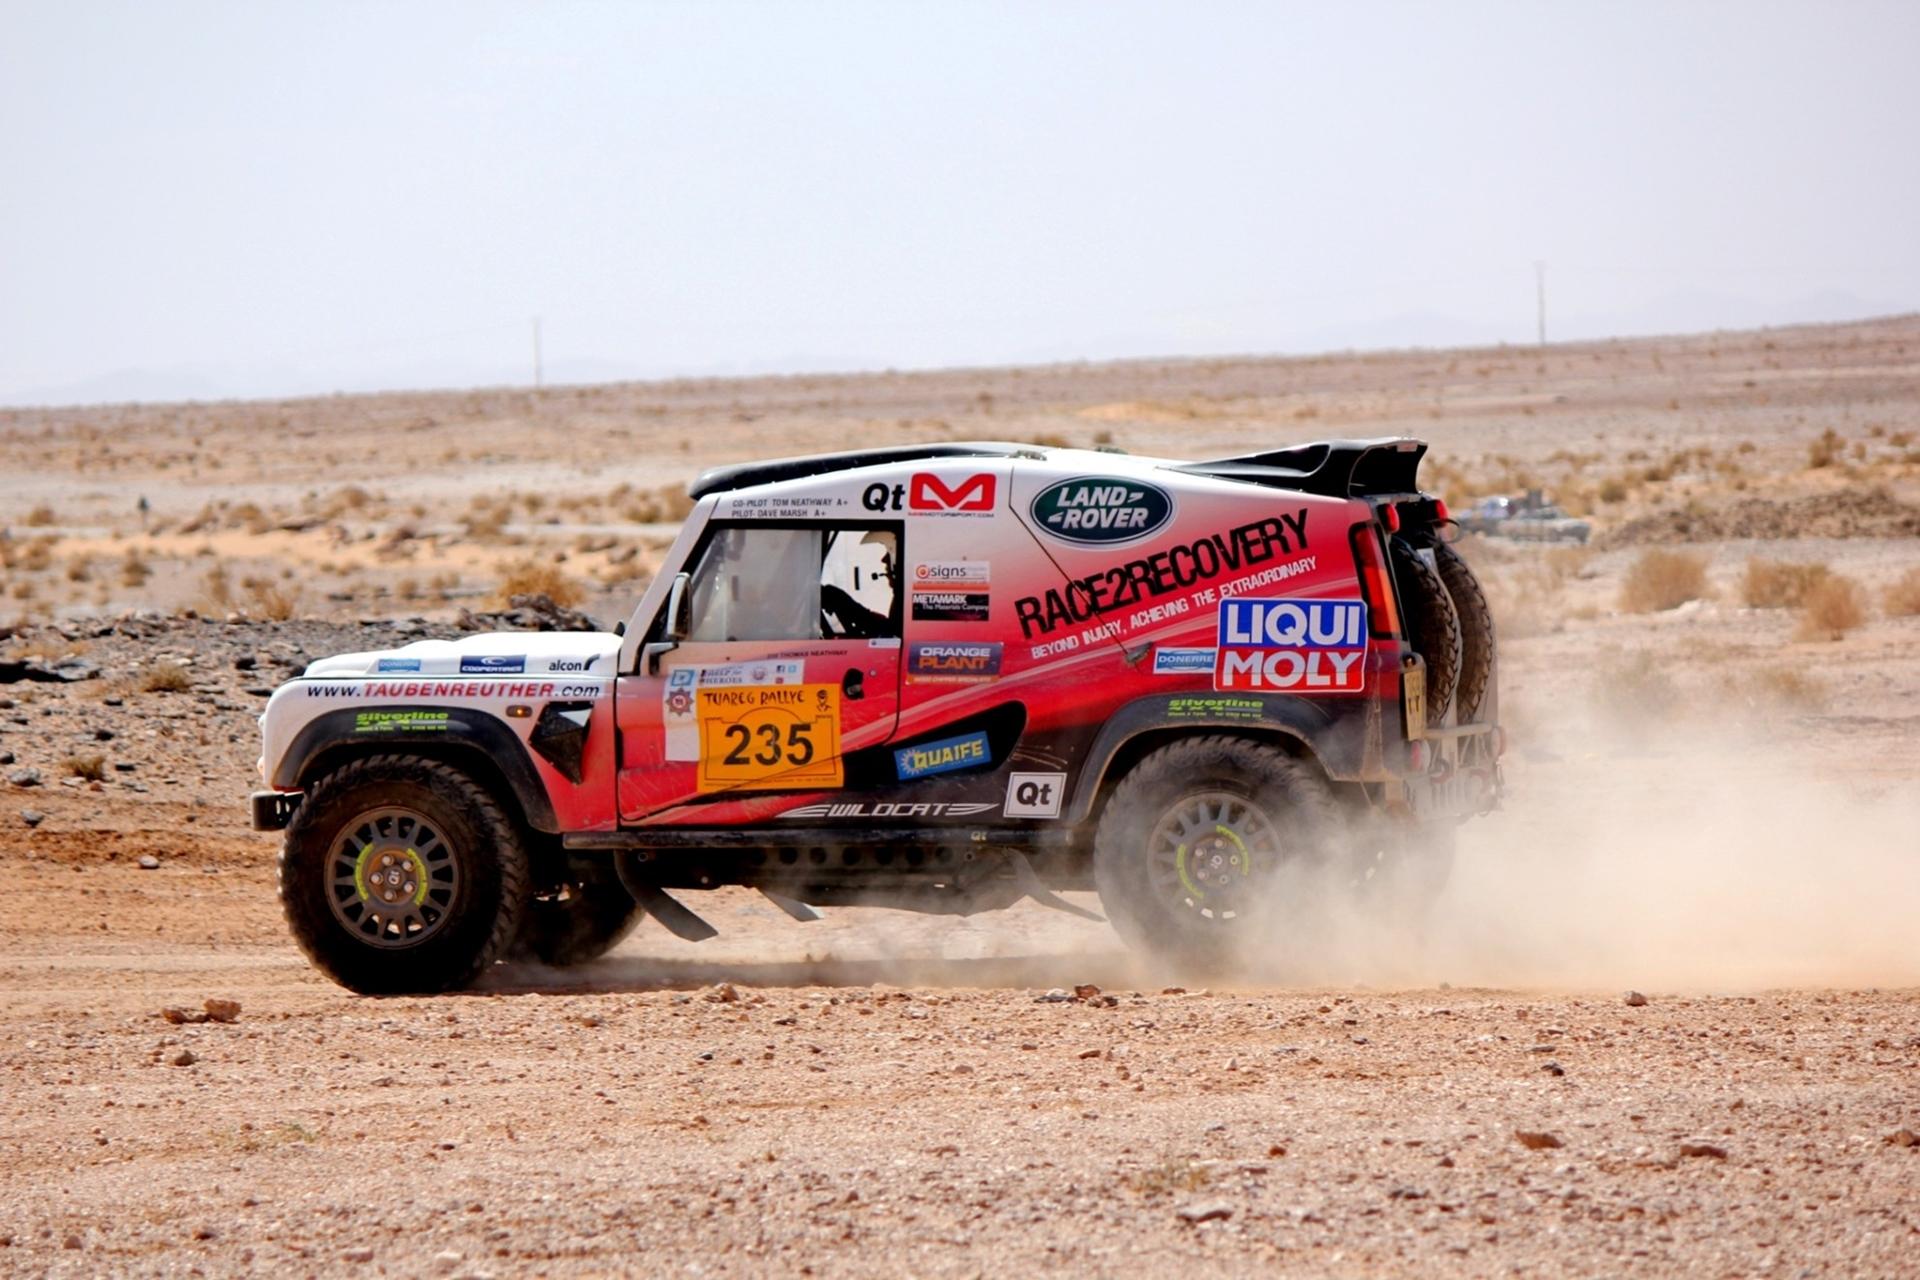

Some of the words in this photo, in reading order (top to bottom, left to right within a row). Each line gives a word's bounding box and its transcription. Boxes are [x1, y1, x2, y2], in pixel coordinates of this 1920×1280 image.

[732, 499, 767, 508] CO-PILOT
[772, 498, 789, 507] TOM
[790, 498, 833, 507] NEATHWAY
[862, 482, 905, 512] Qt
[1057, 486, 1127, 508] LAND
[757, 509, 778, 518] DAVE
[780, 509, 808, 517] MARSH
[1062, 508, 1149, 529] ROVER
[1015, 508, 1309, 640] RACE2RECOVERY
[913, 594, 968, 605] METAMARK
[1031, 635, 1079, 659] BEYOND
[1130, 599, 1189, 629] ACHIEVING
[1192, 588, 1216, 608] THE
[1219, 555, 1317, 597] EXTRAORDINARY
[1226, 603, 1361, 647] LIQUI
[919, 656, 989, 669] PLANT
[920, 647, 991, 657] ORANGE
[549, 659, 582, 671] alcon
[1222, 650, 1362, 688] MOLY
[723, 724, 814, 766] 235
[913, 739, 984, 769] QUAIFE
[1016, 781, 1052, 807] Qt
[827, 803, 950, 817] WILDCAT
